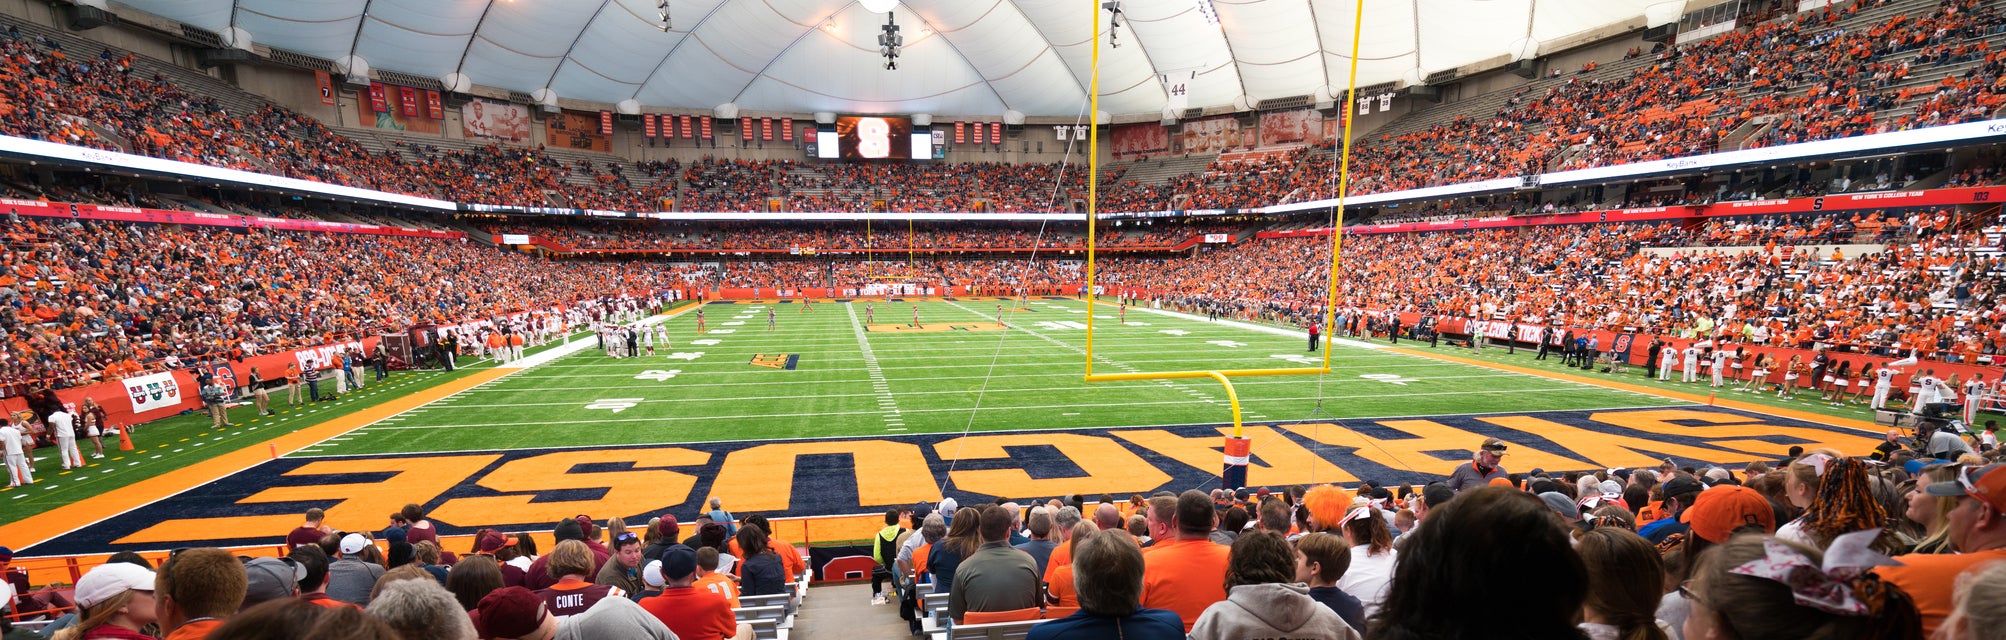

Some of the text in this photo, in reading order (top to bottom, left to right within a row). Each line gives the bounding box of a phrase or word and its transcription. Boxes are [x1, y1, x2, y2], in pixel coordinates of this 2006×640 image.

[1171, 83, 1186, 96] 44
[1667, 160, 1698, 170] KeyBank
[1973, 191, 1989, 201] 103
[1813, 198, 1823, 210] S
[1615, 334, 1630, 353] S
[556, 593, 584, 609] CONTE
